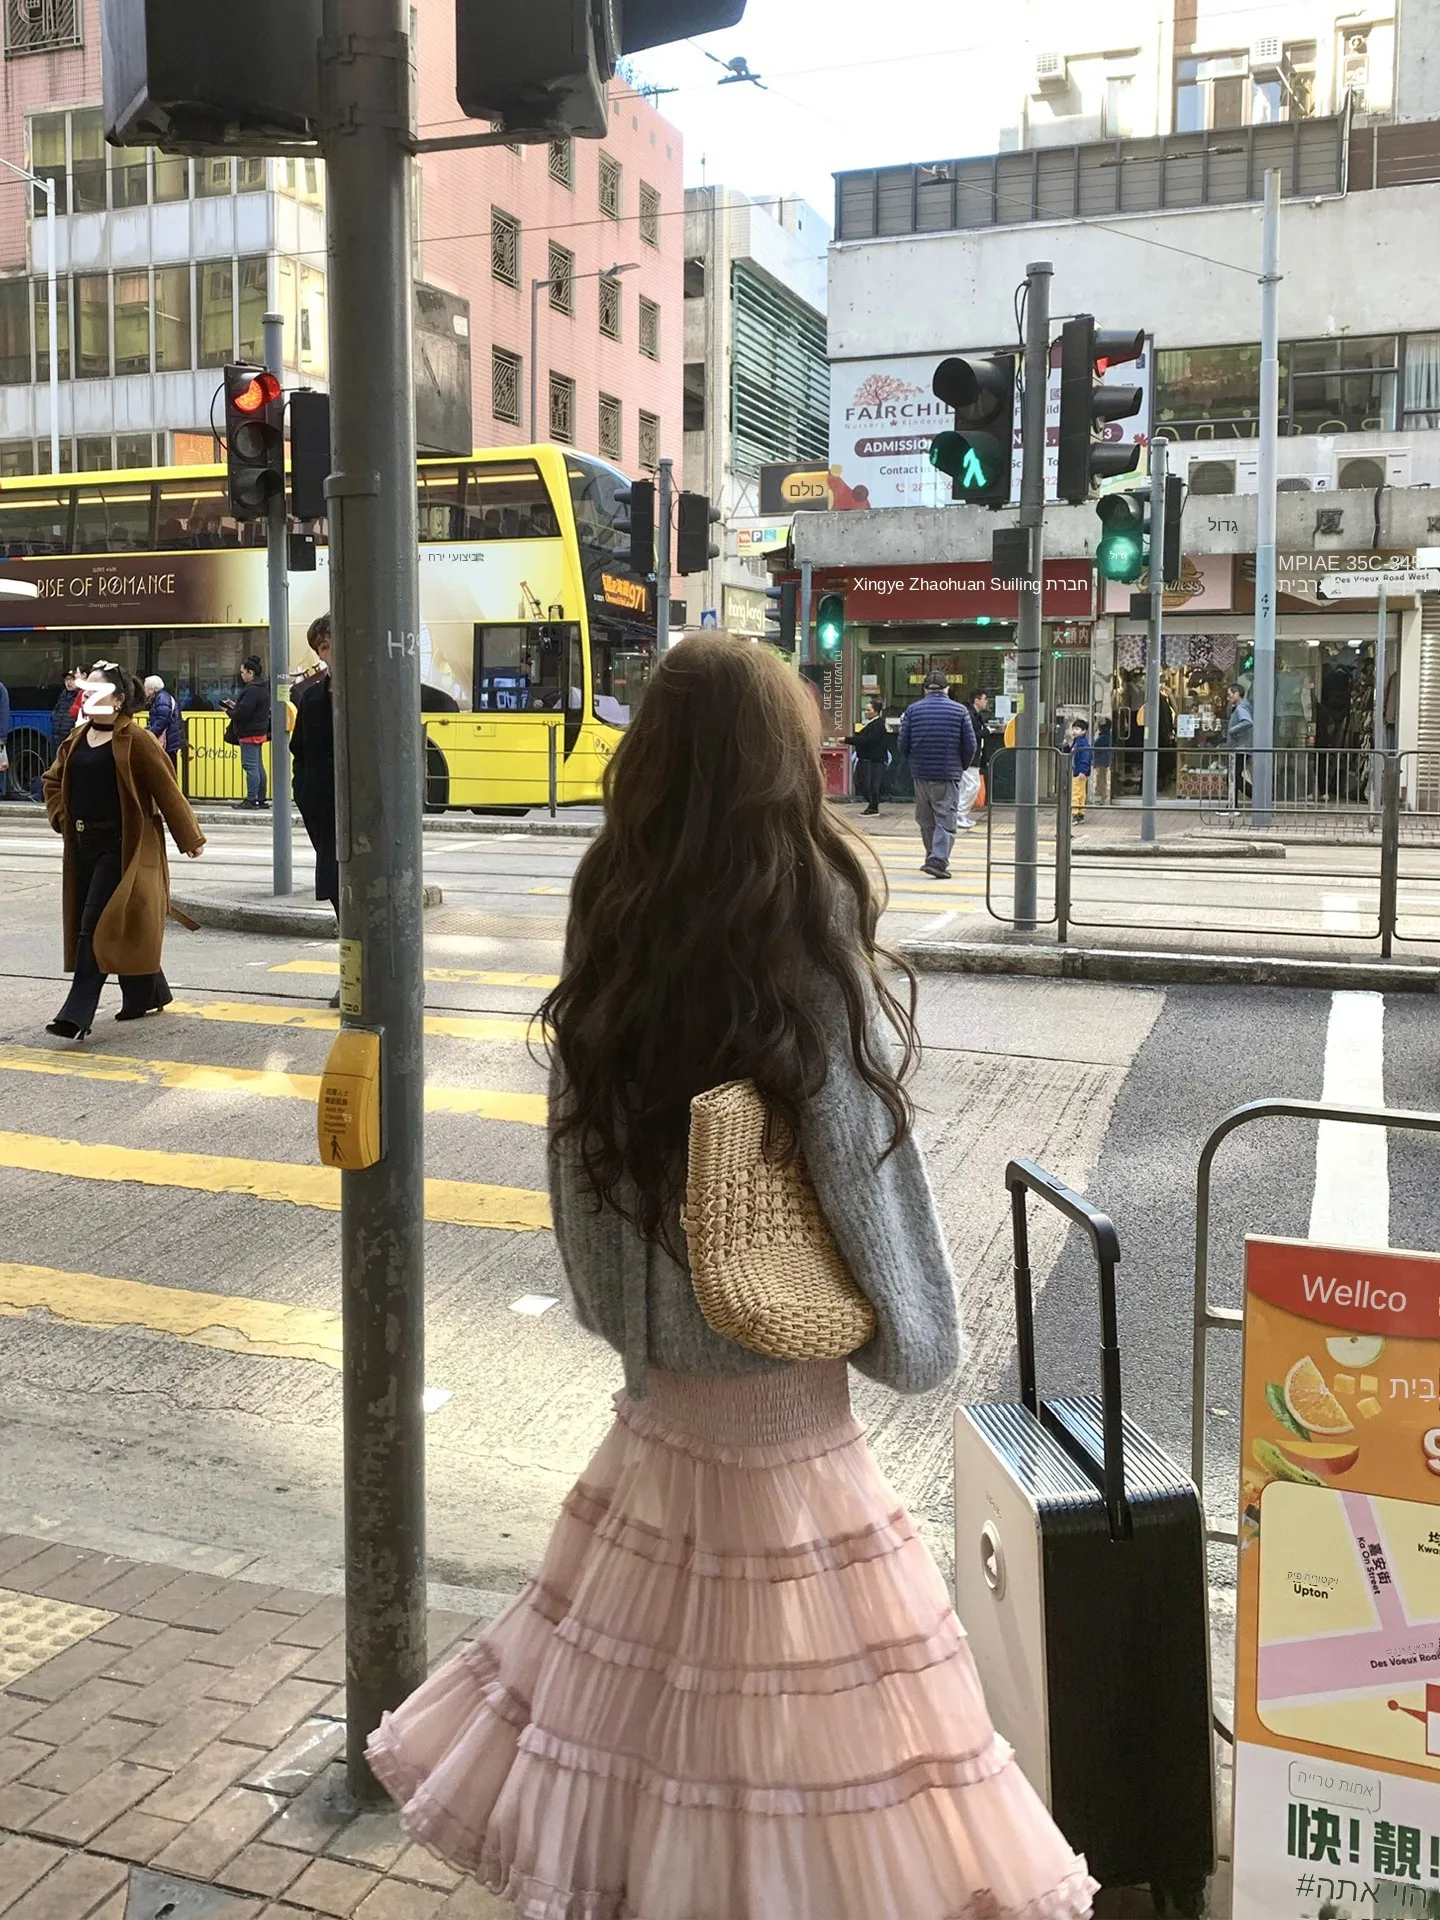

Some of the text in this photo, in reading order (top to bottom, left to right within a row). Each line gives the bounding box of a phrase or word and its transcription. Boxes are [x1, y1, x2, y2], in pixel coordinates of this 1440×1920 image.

[845, 402, 955, 420] FAIRCHIL
[880, 466, 917, 475] Contact
[1383, 573, 1405, 582] Road
[1408, 572, 1430, 580] West
[37, 573, 176, 598] RISE OF ROMANCE
[196, 746, 238, 760] Citybus
[1357, 1536, 1381, 1595] Ka On Street
[1293, 1583, 1329, 1599] Upton
[1370, 1660, 1388, 1669] Des
[1389, 1657, 1418, 1667] Voeux
